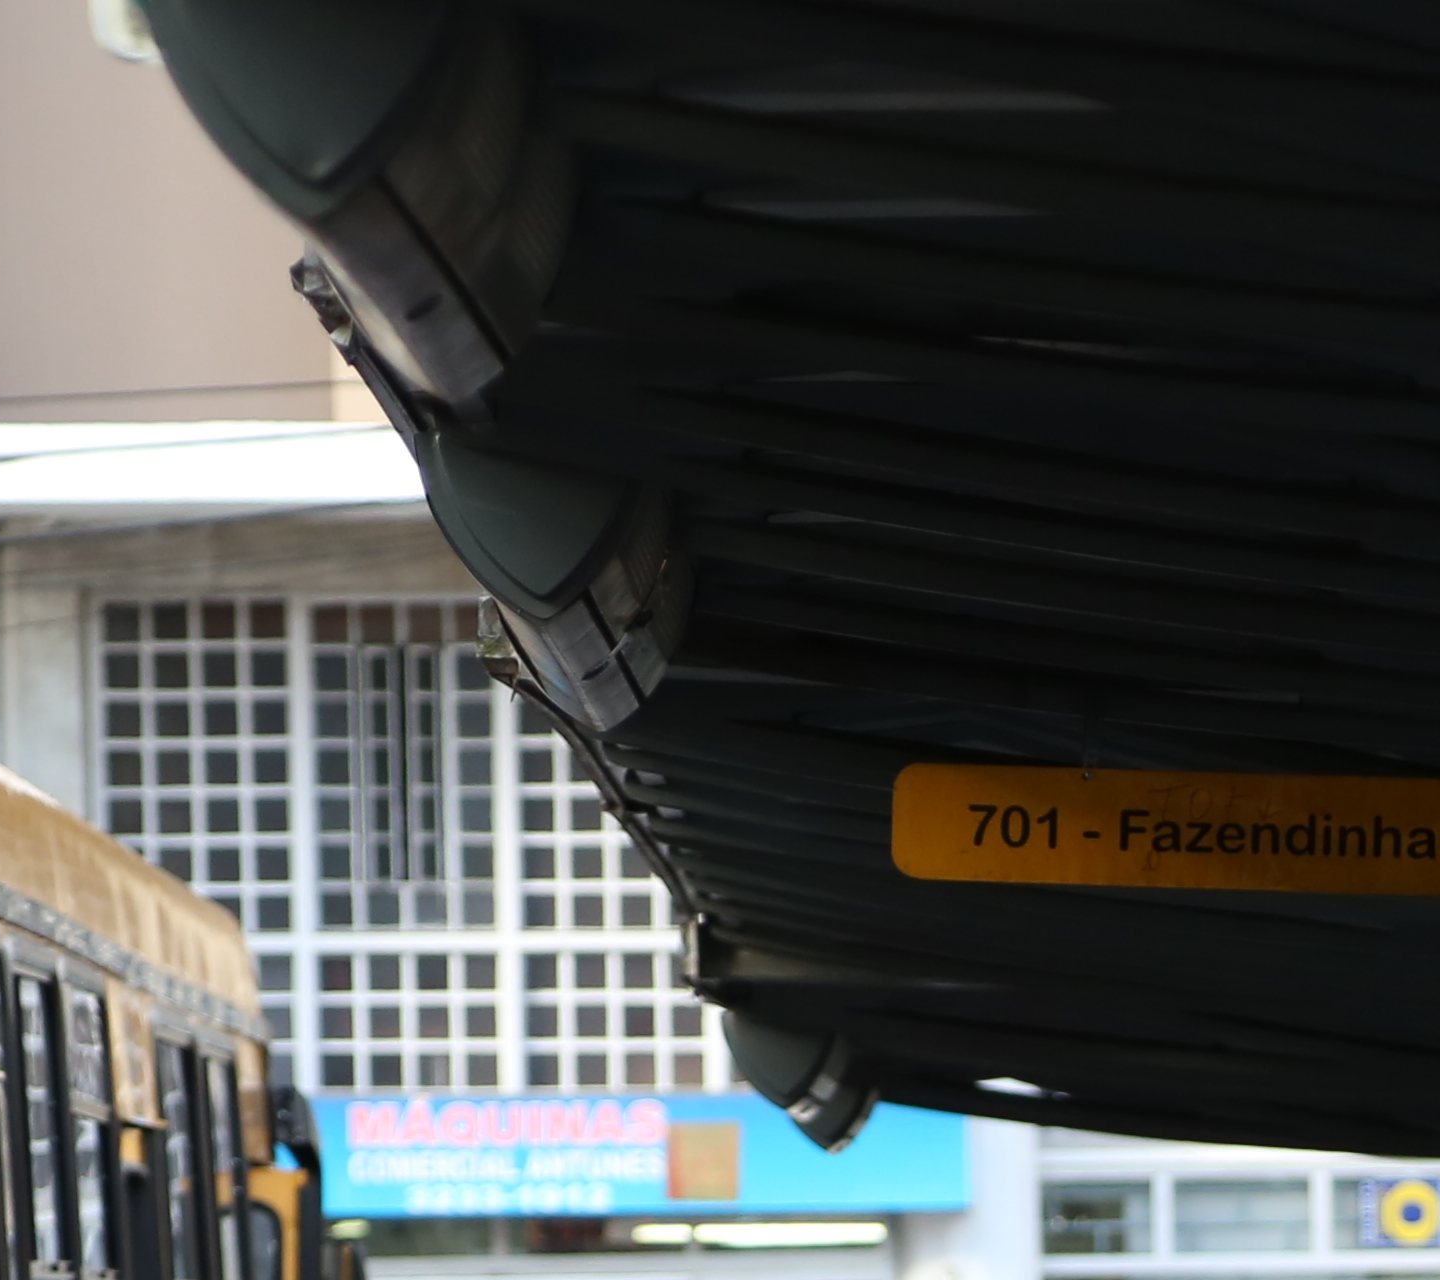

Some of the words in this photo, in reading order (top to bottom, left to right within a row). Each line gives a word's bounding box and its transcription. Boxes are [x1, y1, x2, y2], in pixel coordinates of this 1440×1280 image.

[967, 804, 1061, 849] 701
[1119, 808, 1438, 860] Fazendinha
[348, 1095, 668, 1147] MÁQUINAS
